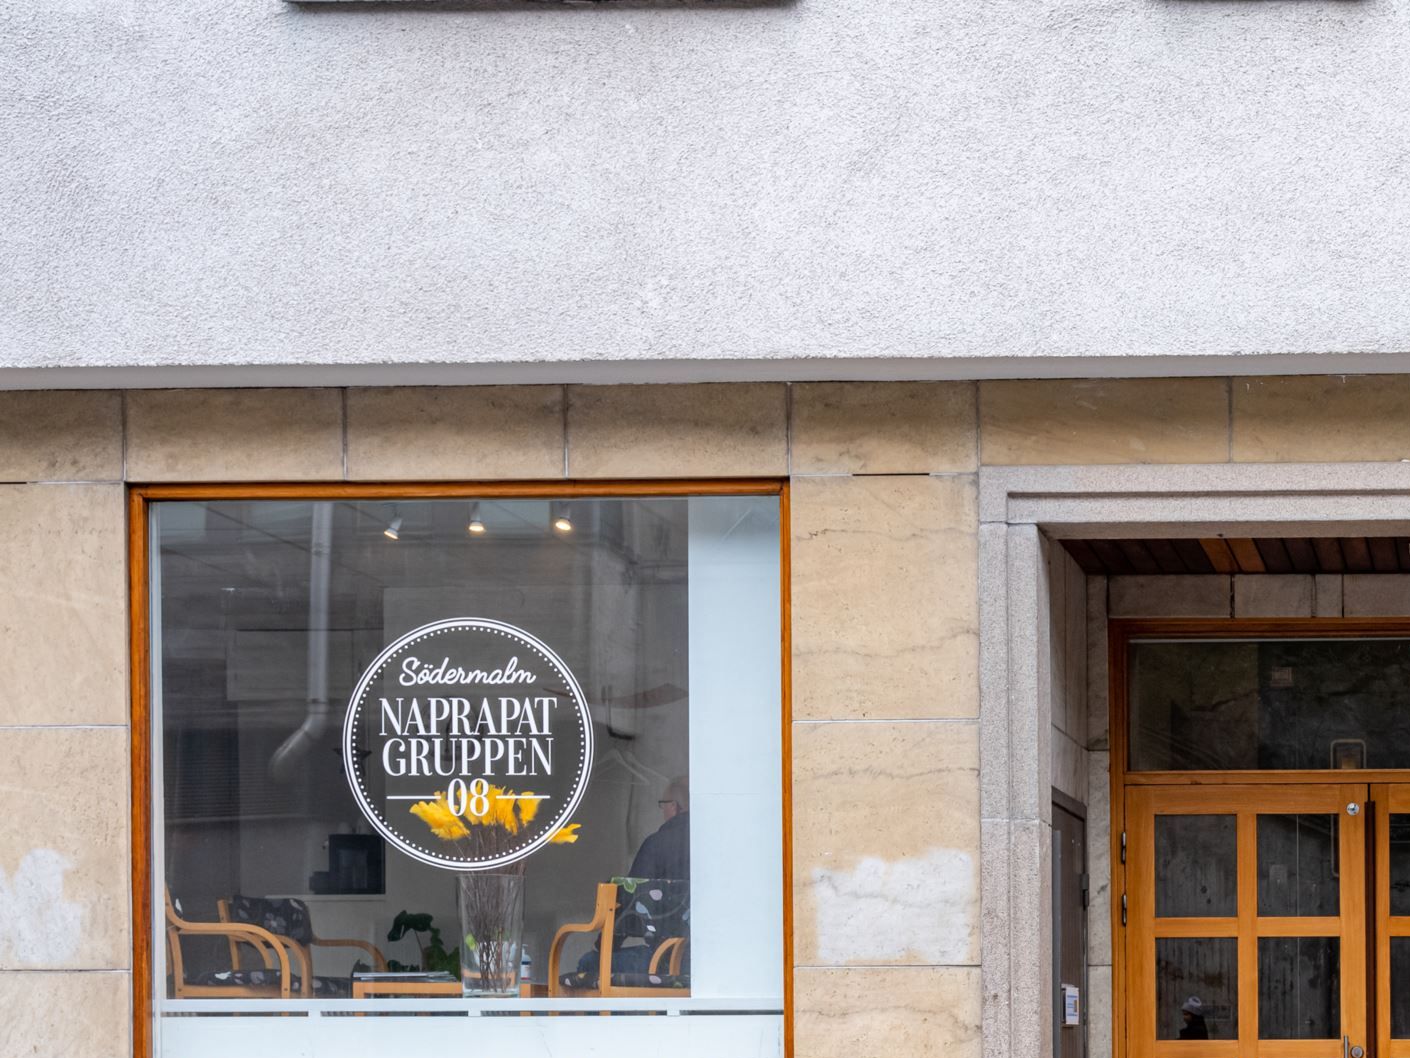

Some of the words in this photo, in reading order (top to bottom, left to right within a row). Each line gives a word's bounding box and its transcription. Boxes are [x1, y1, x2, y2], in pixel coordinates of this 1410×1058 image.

[399, 656, 536, 686] Södermalm
[379, 697, 557, 736] NAPRAPAT
[382, 738, 554, 776] GRUPPEN
[447, 778, 490, 817] 08
